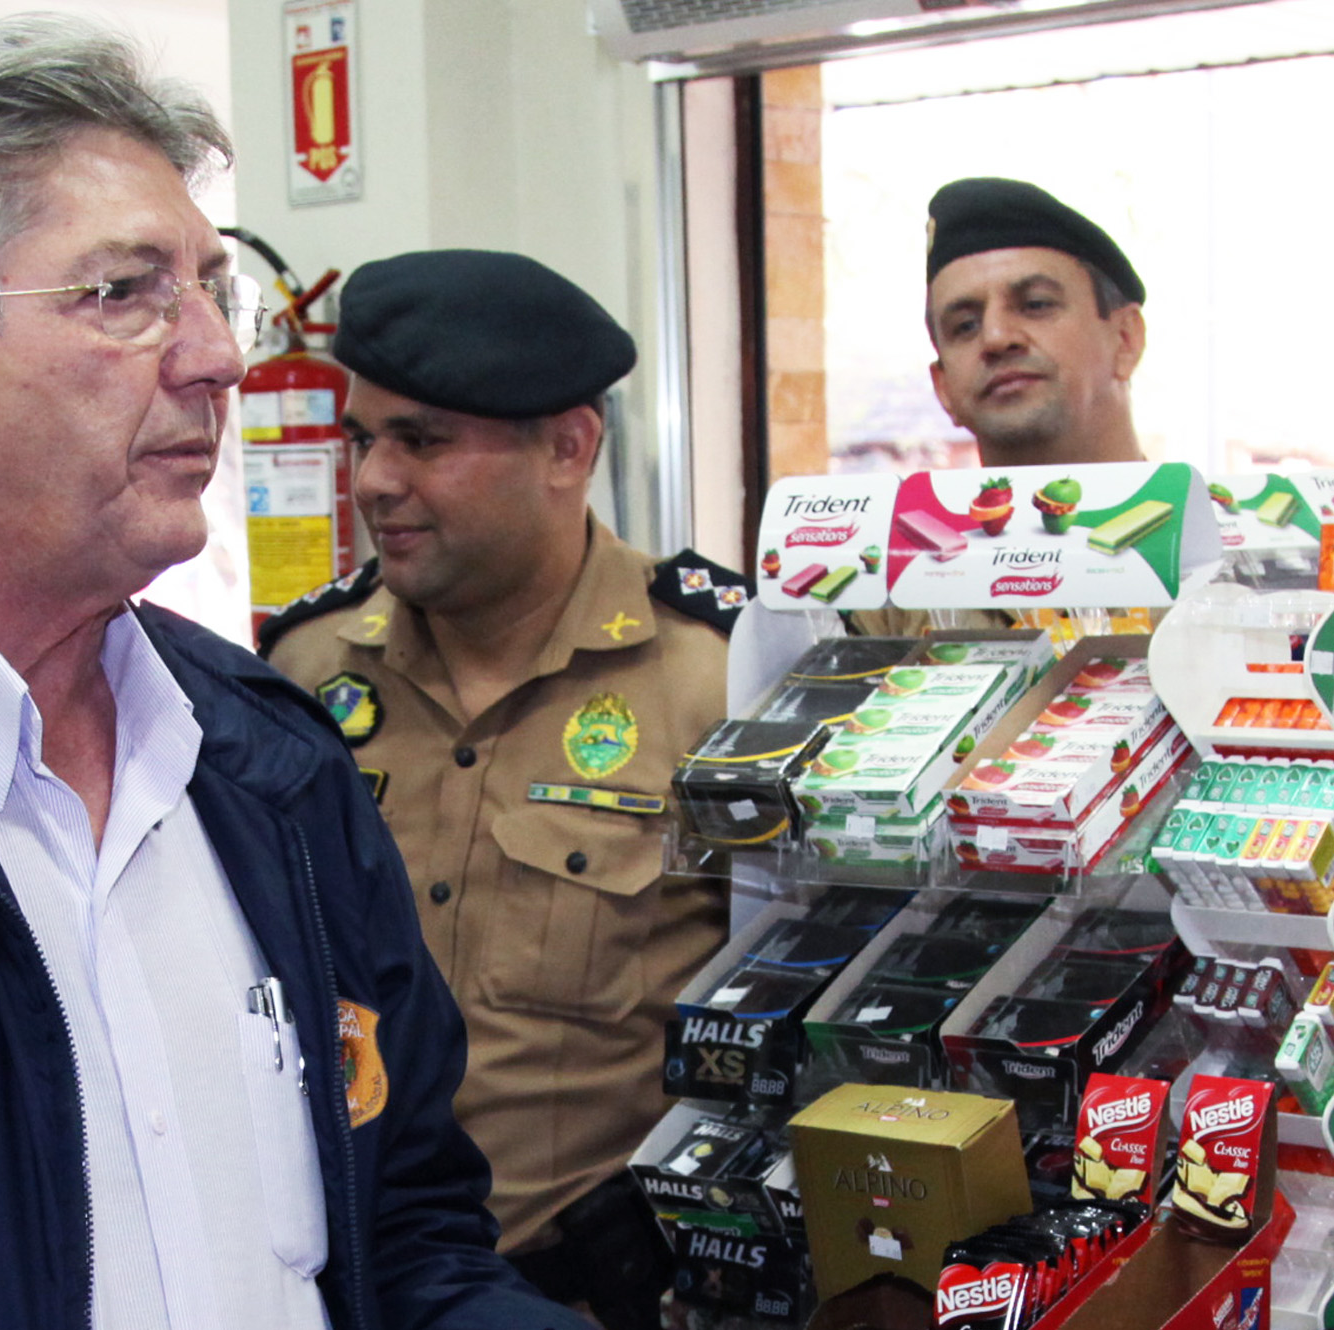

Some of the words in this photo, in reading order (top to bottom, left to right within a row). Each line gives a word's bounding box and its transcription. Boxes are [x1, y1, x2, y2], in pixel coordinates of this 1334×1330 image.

[784, 494, 872, 518] Trident
[789, 528, 849, 544] sensations
[992, 547, 1063, 566] Trident
[994, 578, 1053, 593] sensations
[681, 1016, 766, 1049] HALLS
[1092, 1001, 1144, 1062] Trident
[697, 1047, 746, 1078] XS
[859, 1045, 910, 1064] Trident
[1002, 1060, 1057, 1079] Trident
[850, 1101, 950, 1122] ALPINO
[1087, 1092, 1152, 1129] Nestlé
[1190, 1095, 1255, 1132] Nestlé
[1110, 1137, 1148, 1156] CLASSIC
[1213, 1141, 1252, 1159] CLASSIC
[643, 1177, 704, 1201] HALLS
[835, 1168, 928, 1201] ALPINO
[689, 1232, 768, 1269] HALLS
[937, 1273, 1013, 1314] Nestlé
